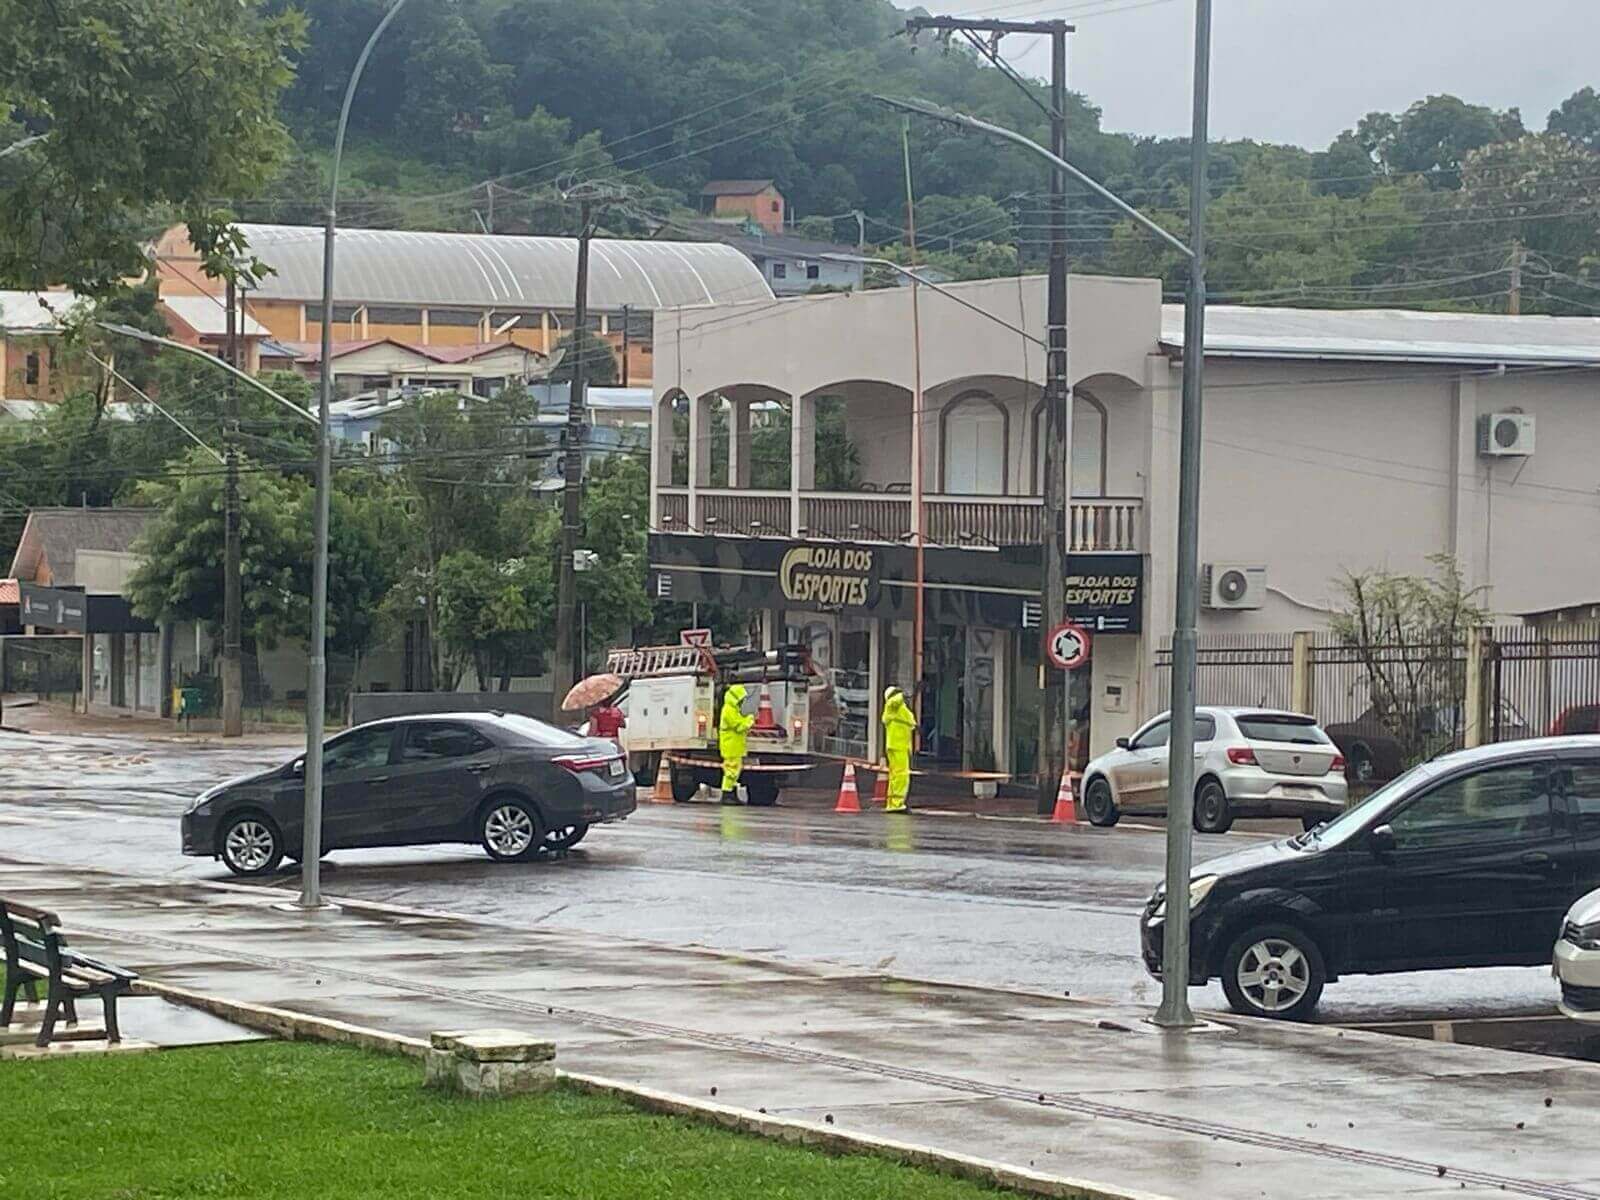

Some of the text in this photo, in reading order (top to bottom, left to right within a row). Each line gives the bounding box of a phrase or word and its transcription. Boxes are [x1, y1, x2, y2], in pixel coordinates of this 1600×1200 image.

[807, 547, 872, 571] LOJA DOS
[792, 573, 869, 605] ESPORTES
[1079, 576, 1138, 588] LOJA DOS
[1066, 588, 1136, 605] ESPORTES
